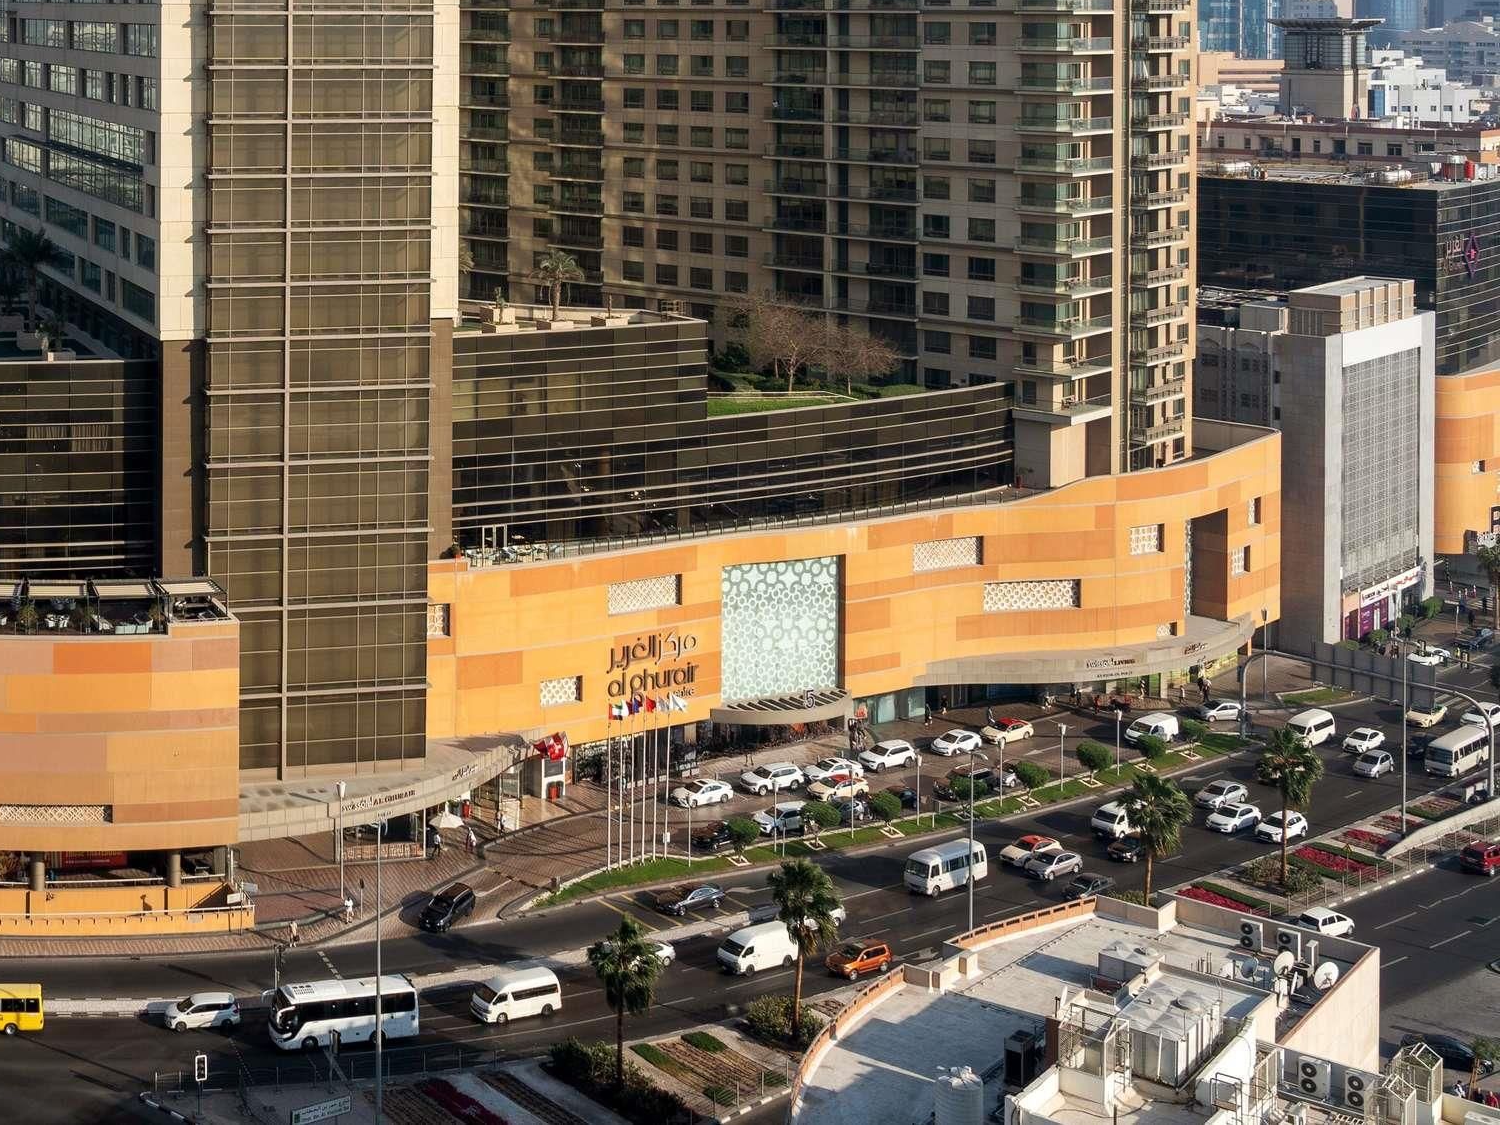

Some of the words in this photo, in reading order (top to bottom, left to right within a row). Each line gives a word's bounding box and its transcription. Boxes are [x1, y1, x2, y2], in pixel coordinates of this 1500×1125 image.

[606, 634, 657, 674] الغرير
[654, 631, 697, 665] مركز
[607, 671, 627, 697] al
[629, 661, 699, 704] ghurair
[805, 689, 815, 709] 5
